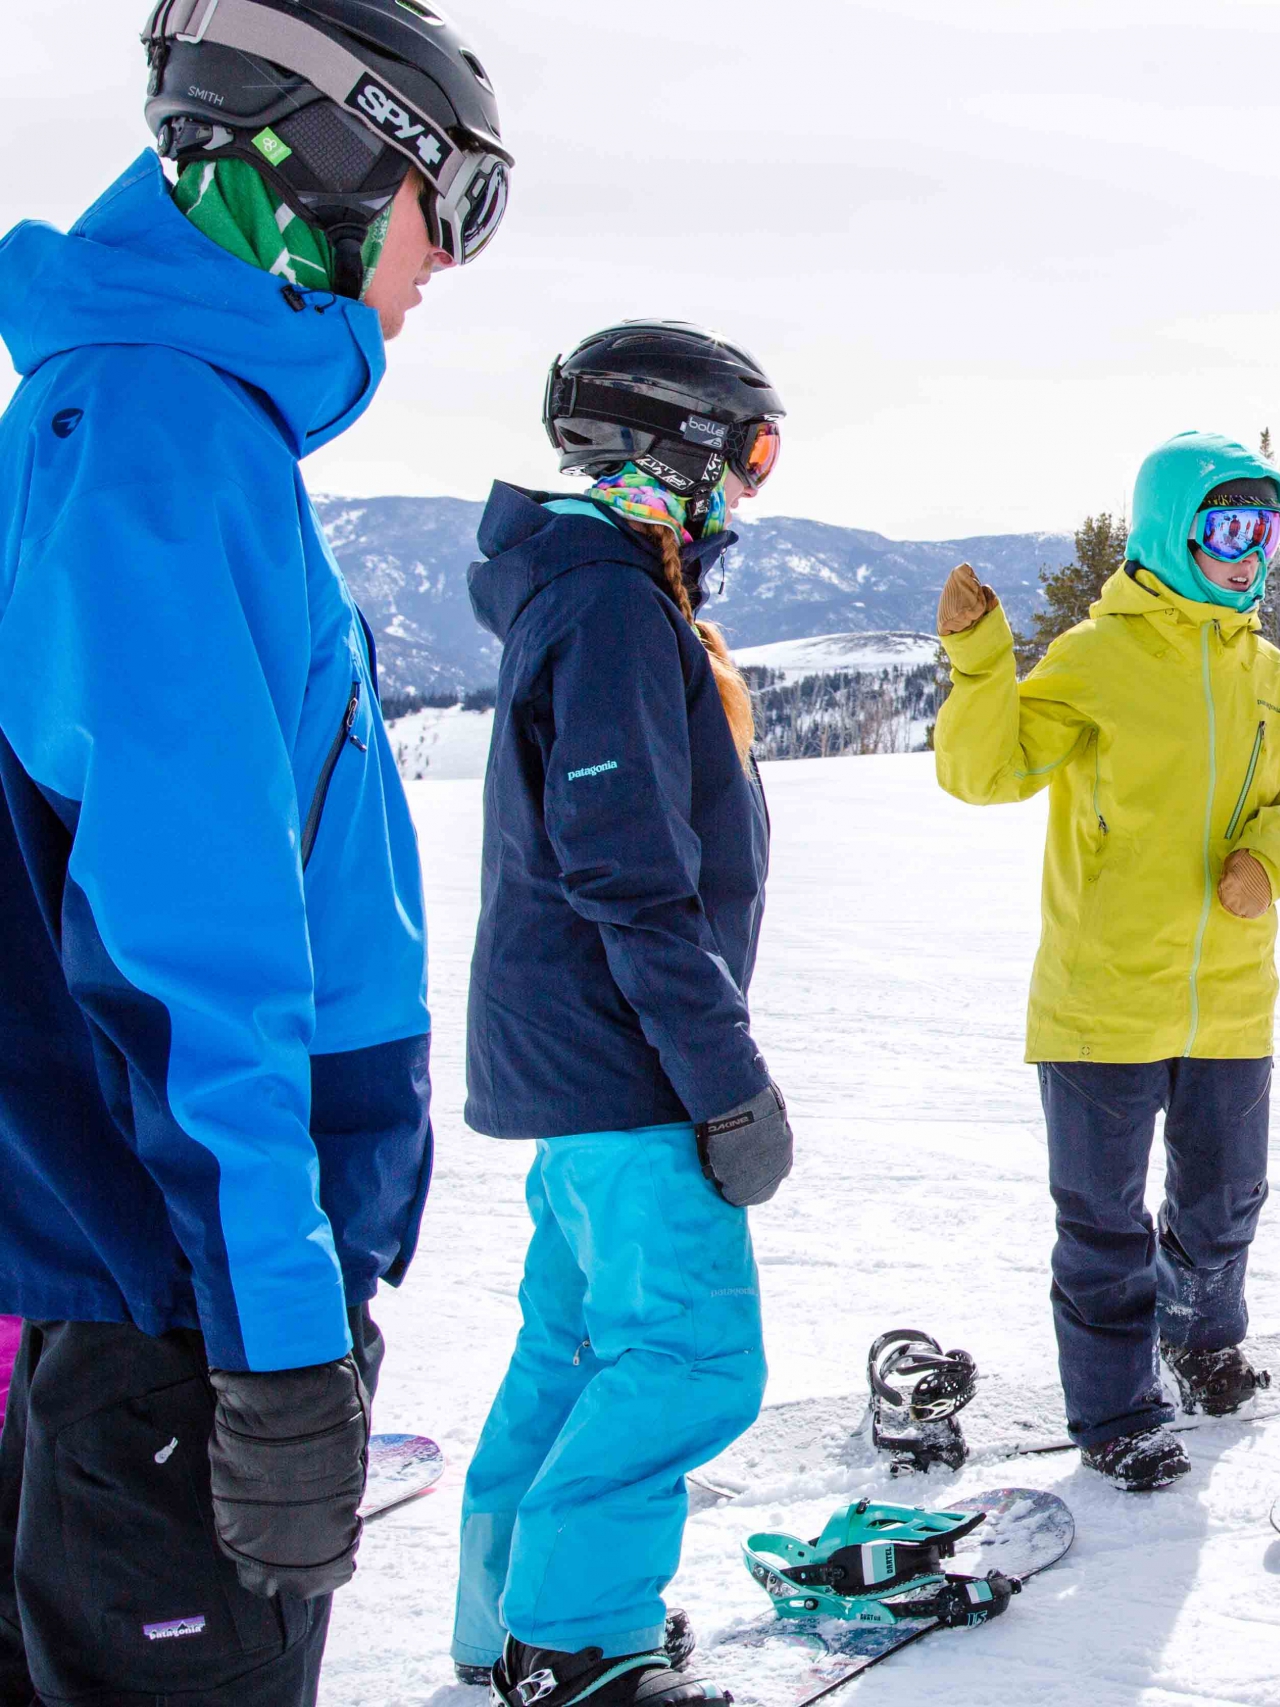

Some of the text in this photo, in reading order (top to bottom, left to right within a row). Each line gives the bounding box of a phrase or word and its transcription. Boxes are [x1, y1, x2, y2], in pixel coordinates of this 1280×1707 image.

[187, 85, 224, 106] SMITH
[567, 760, 618, 781] patagonia
[149, 1626, 202, 1640] patagonia
